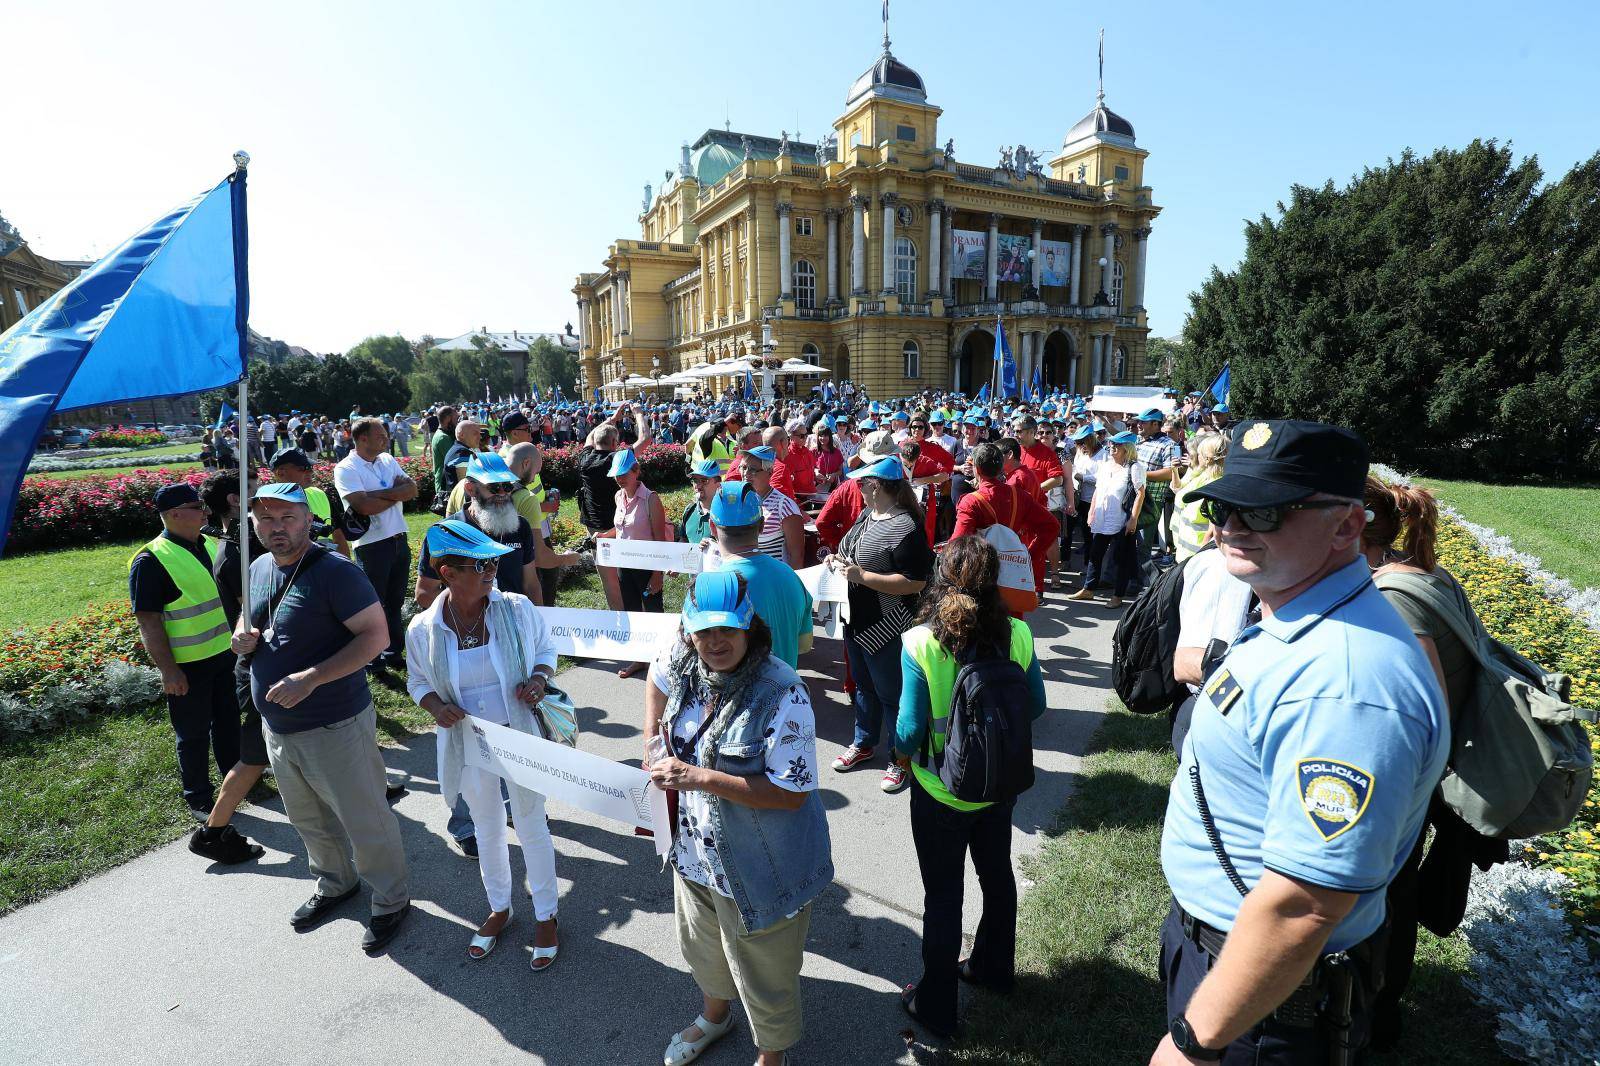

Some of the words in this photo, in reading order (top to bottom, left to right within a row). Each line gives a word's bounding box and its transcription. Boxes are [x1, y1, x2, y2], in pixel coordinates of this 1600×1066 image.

[952, 236, 985, 247] DRAMA
[551, 625, 581, 639] KOLIKO
[583, 628, 604, 641] VAM
[550, 766, 561, 778] DO
[1301, 764, 1367, 788] POLICIJA
[1315, 801, 1345, 813] MUP
